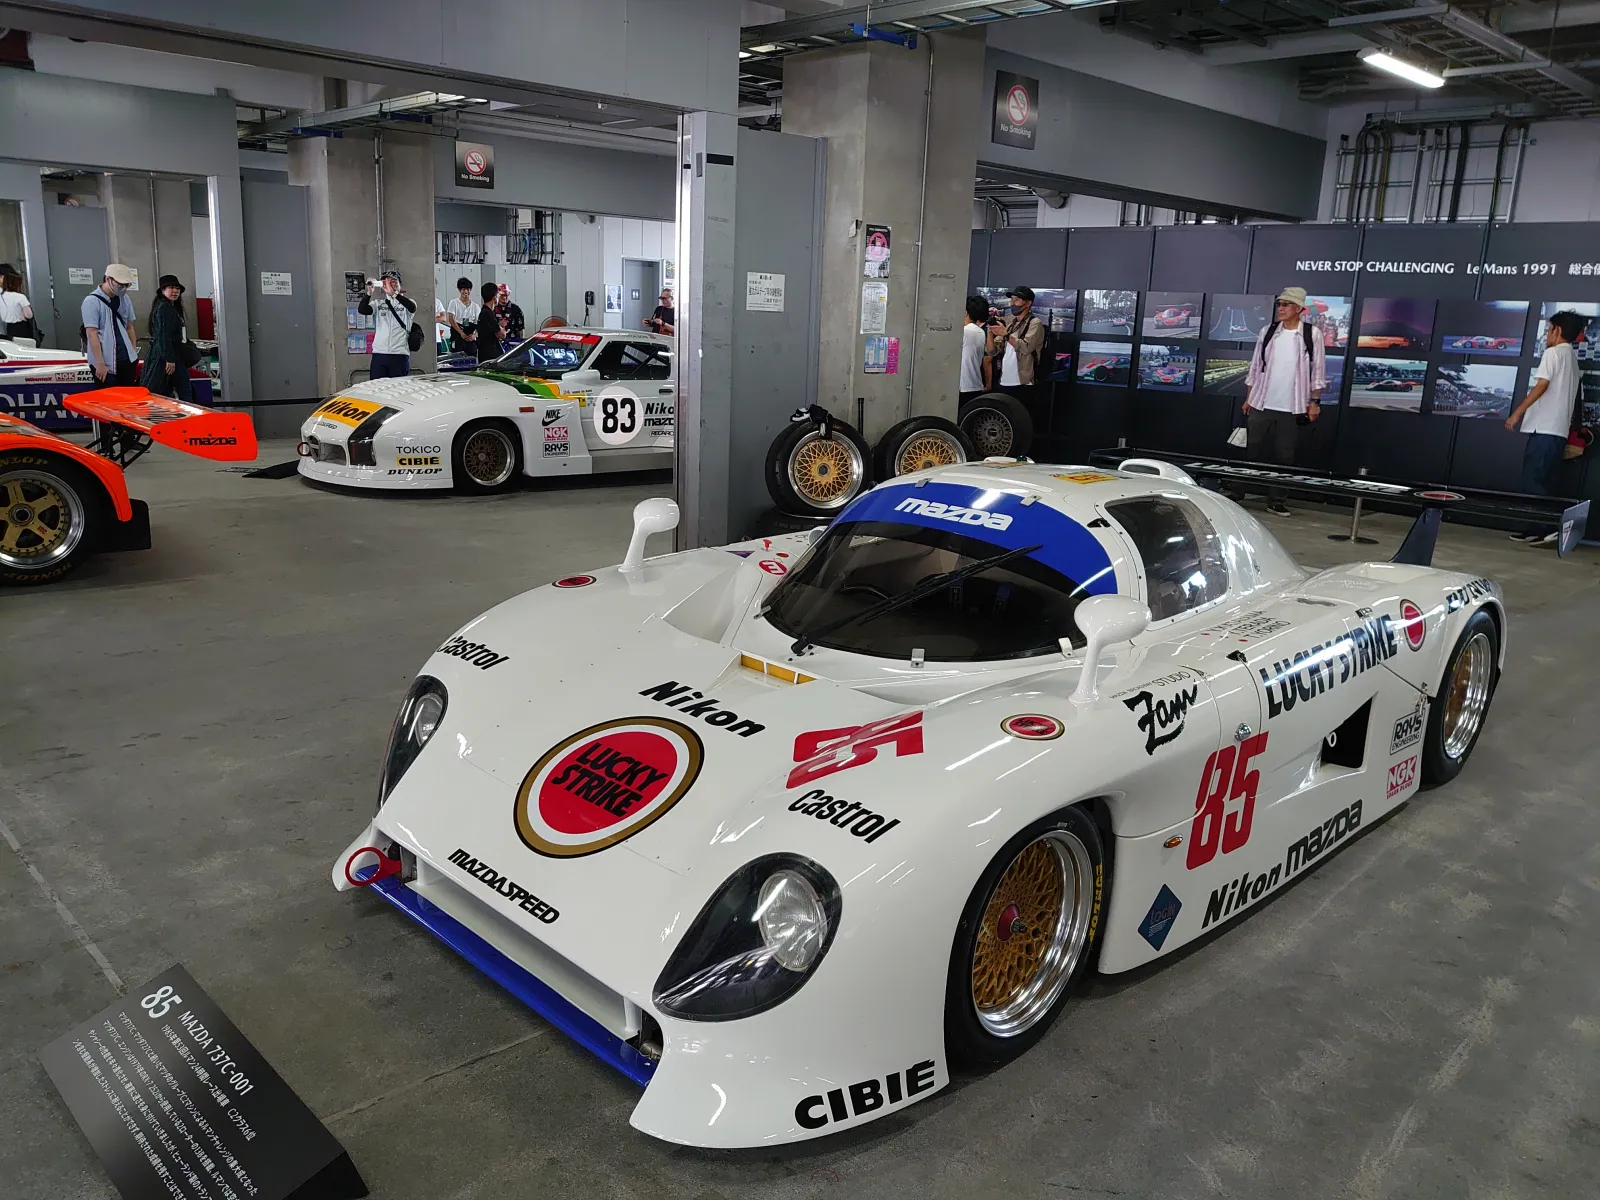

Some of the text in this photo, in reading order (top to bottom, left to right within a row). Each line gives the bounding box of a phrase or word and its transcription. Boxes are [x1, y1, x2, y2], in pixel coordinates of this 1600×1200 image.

[1000, 123, 1032, 138] No Smoking
[469, 174, 490, 182] Smoking
[1296, 260, 1455, 274] NEVER STOP CHALLENGING
[1522, 263, 1557, 275] 1991
[318, 400, 371, 422] Nikon
[545, 409, 562, 419] NIKE
[602, 397, 636, 434] 83
[645, 402, 675, 415] Niko
[189, 437, 237, 446] mazda
[544, 427, 569, 438] NGK
[544, 442, 569, 452] RAYS
[396, 445, 441, 454] TOKICO
[894, 497, 1014, 531] mazda
[1152, 670, 1191, 687] STUDIO
[1259, 613, 1398, 719] LUCKY STRIKE
[637, 680, 766, 739] Nikon
[1393, 715, 1422, 742] RAYS
[576, 742, 669, 798] LUCKY
[1387, 755, 1418, 793] NGK
[551, 763, 645, 818] STRIKE
[1186, 730, 1269, 870] 85
[788, 788, 901, 844] Castrol
[1284, 798, 1363, 878] mazda
[446, 848, 561, 925] MAZDASPEED
[1201, 862, 1282, 930] Nikon
[140, 985, 183, 1018] 85
[177, 1010, 254, 1096] MAZDA 737C-001
